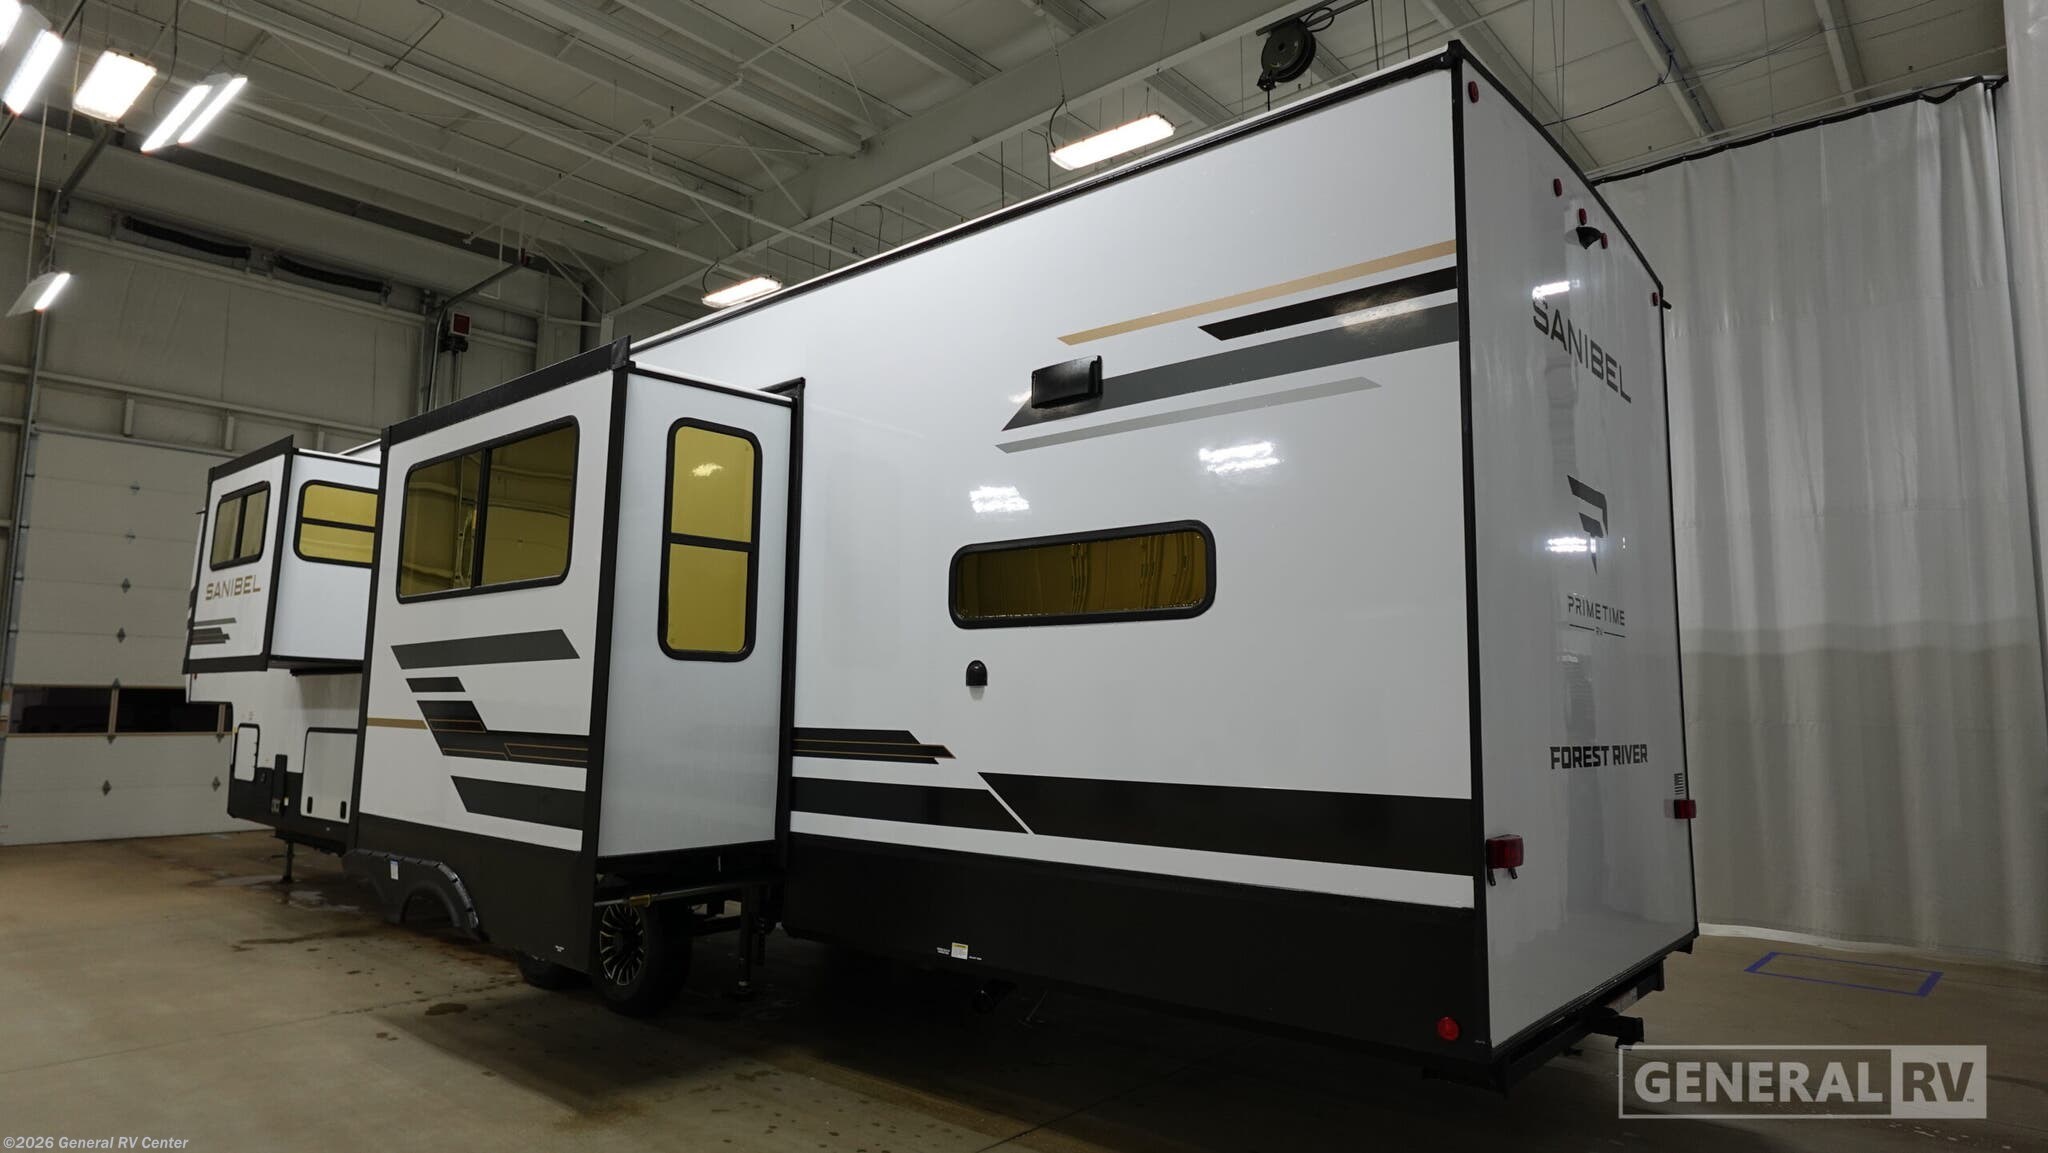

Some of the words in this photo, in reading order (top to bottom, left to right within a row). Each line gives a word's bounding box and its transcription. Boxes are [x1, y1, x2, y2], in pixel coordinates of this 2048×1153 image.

[1532, 296, 1632, 404] SANIBEL
[205, 575, 261, 601] SANIBEL
[1549, 745, 1610, 770] FOREST
[1611, 743, 1649, 766] RIVER
